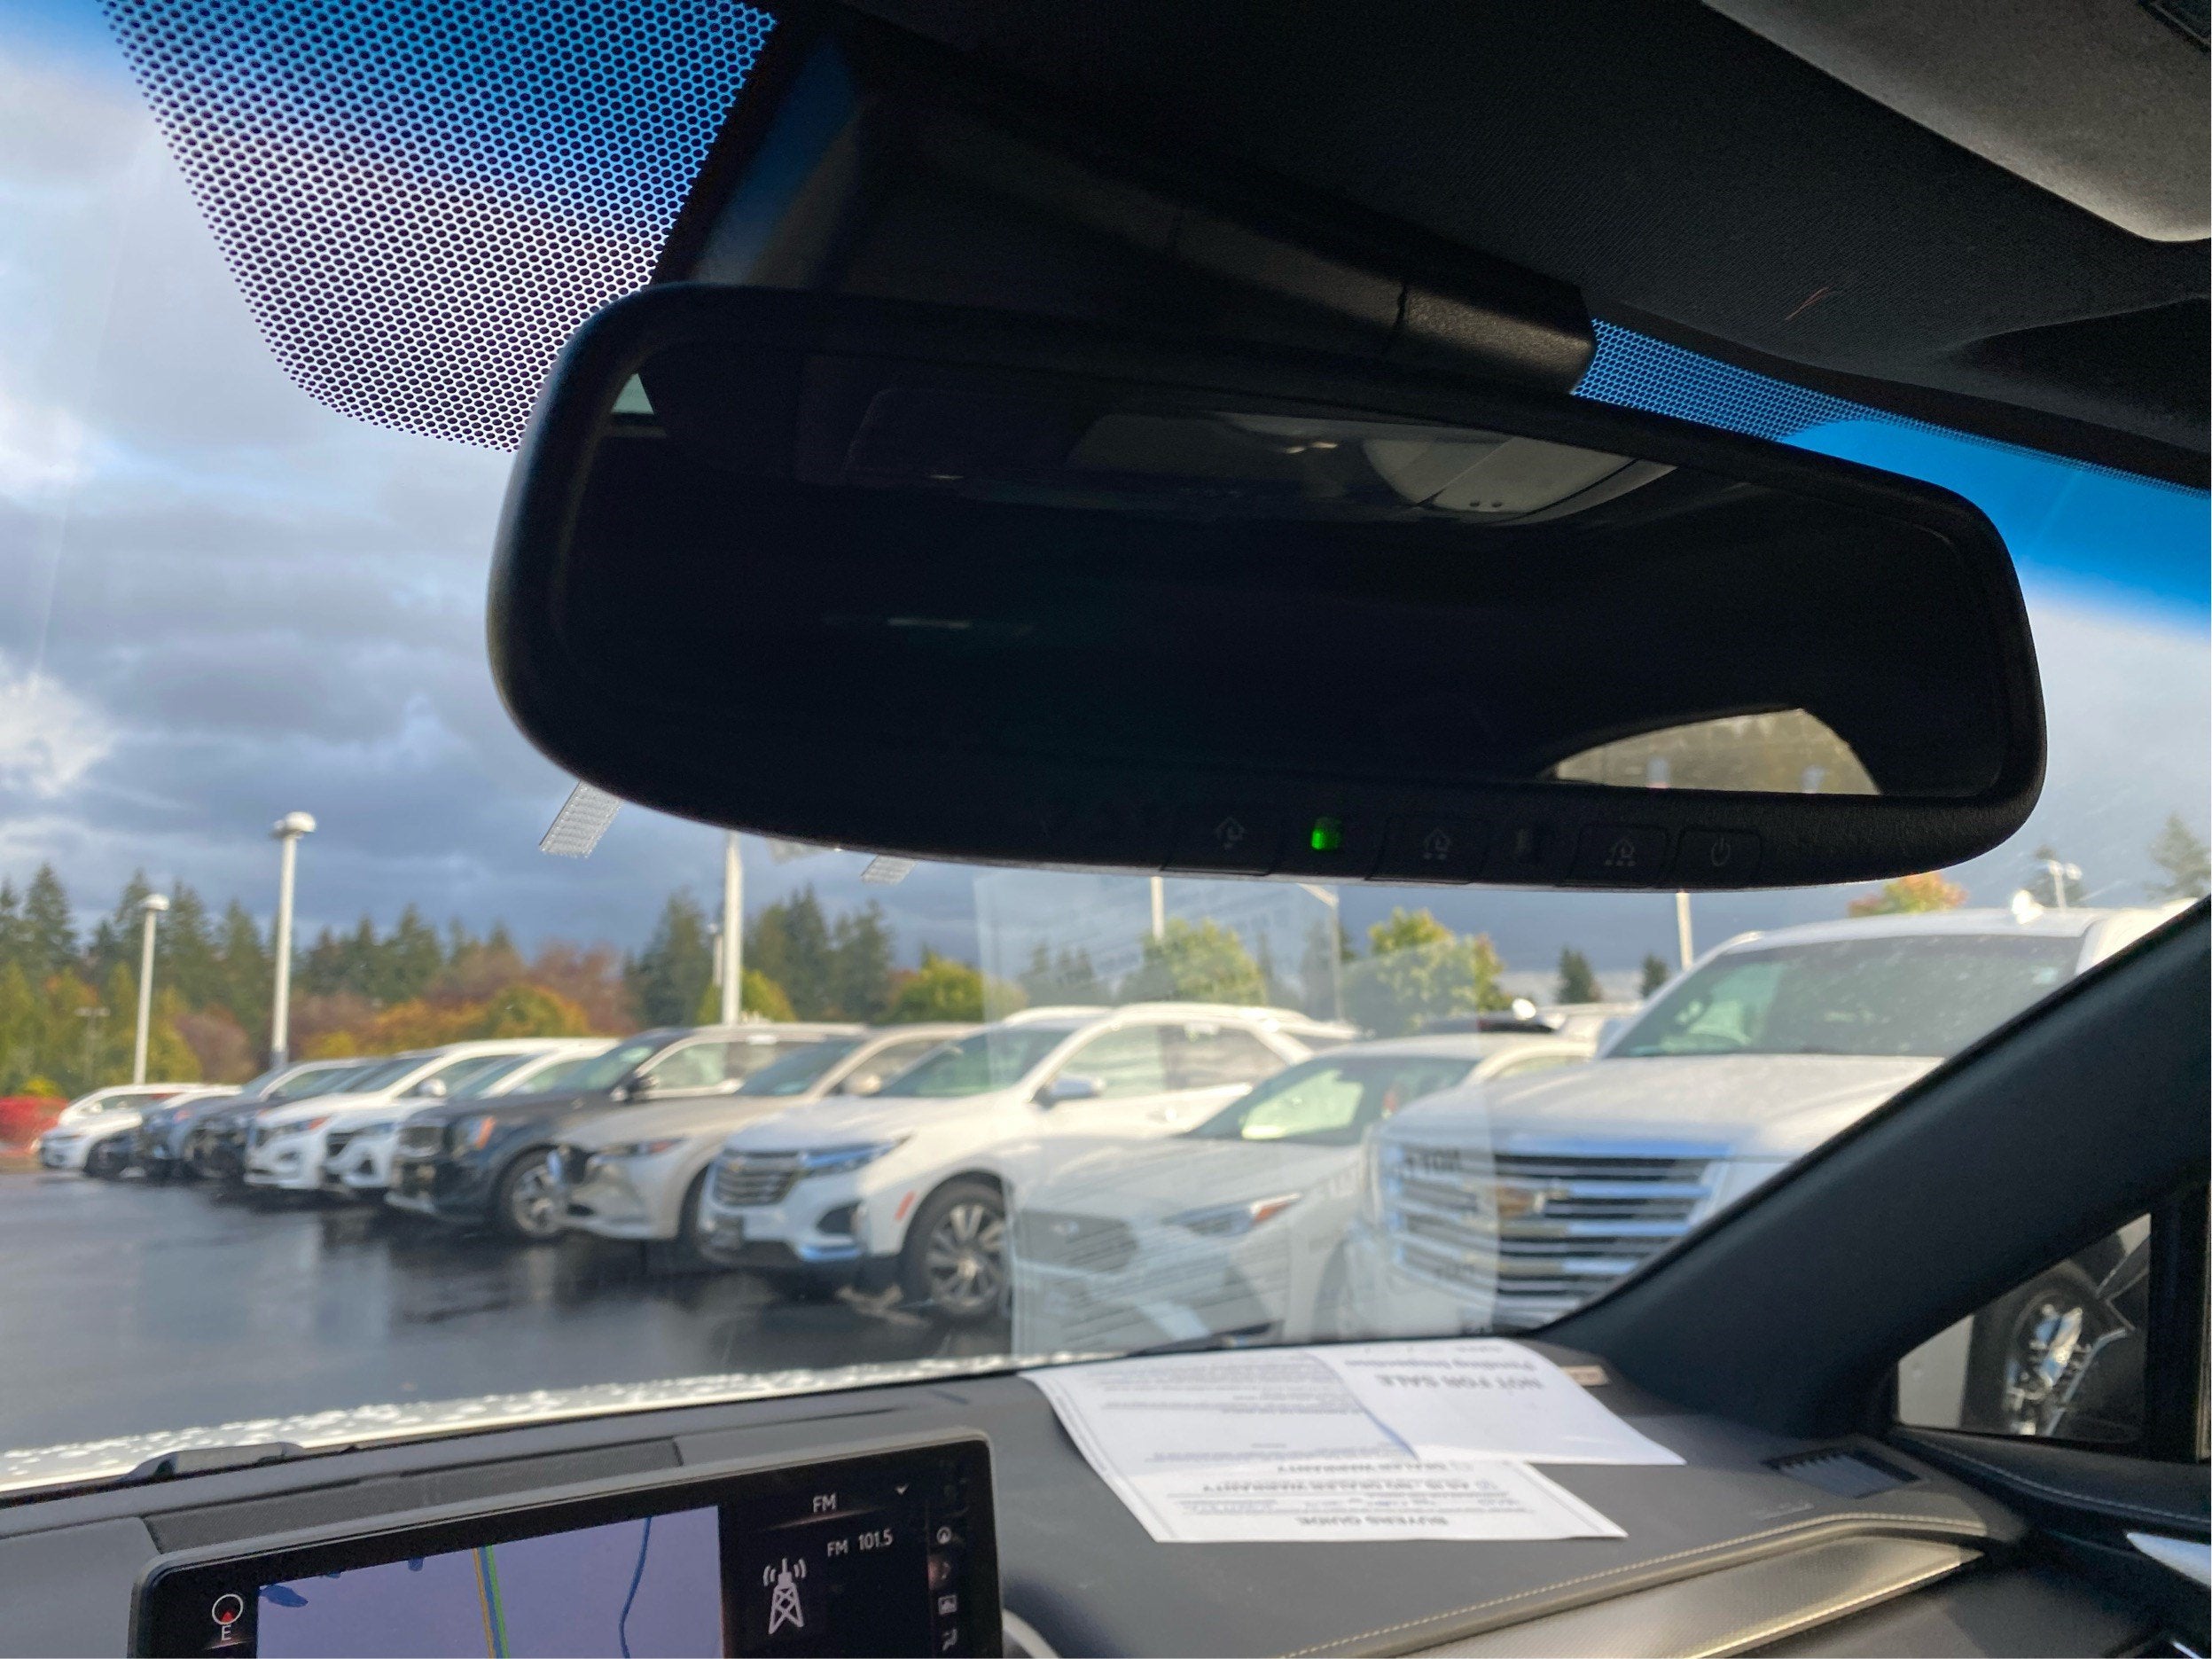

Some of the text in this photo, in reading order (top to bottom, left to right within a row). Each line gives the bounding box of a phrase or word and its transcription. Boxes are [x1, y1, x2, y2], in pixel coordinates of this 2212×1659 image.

[1374, 1374, 1544, 1390] NOT FOR SALE
[813, 1492, 837, 1513] FM
[827, 1529, 894, 1557] FM 101.5
[222, 1624, 231, 1641] E
